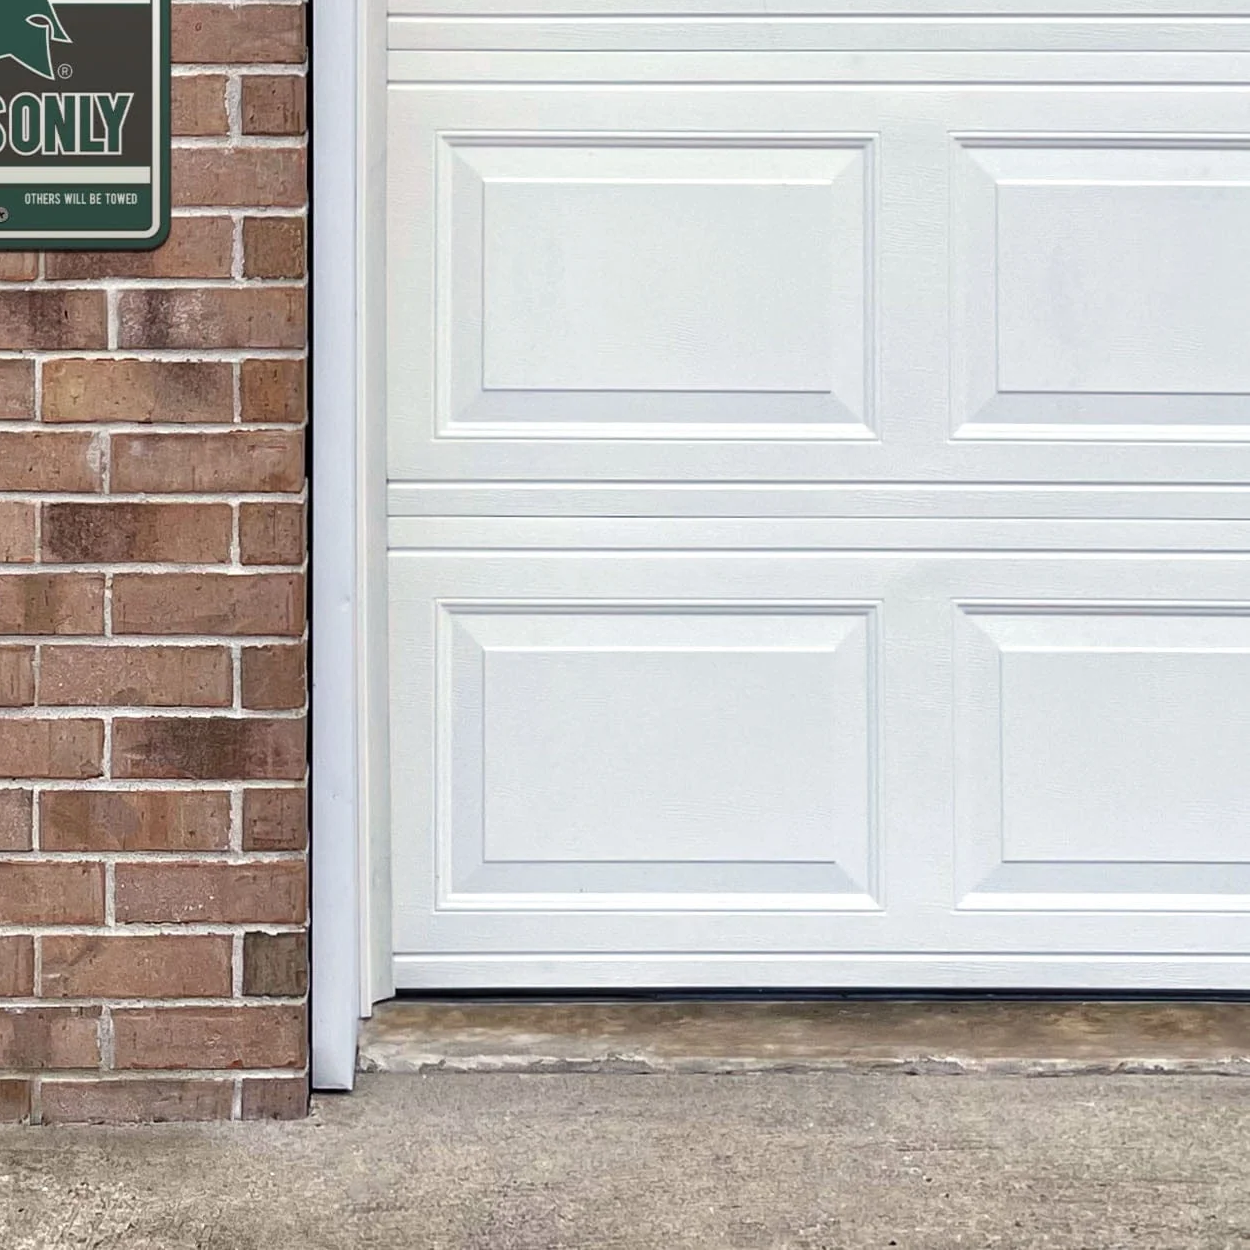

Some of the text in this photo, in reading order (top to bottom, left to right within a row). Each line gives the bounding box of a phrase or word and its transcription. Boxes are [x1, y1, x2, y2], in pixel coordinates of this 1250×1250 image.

[23, 192, 138, 205] OTHERS WILL BE TOWED
